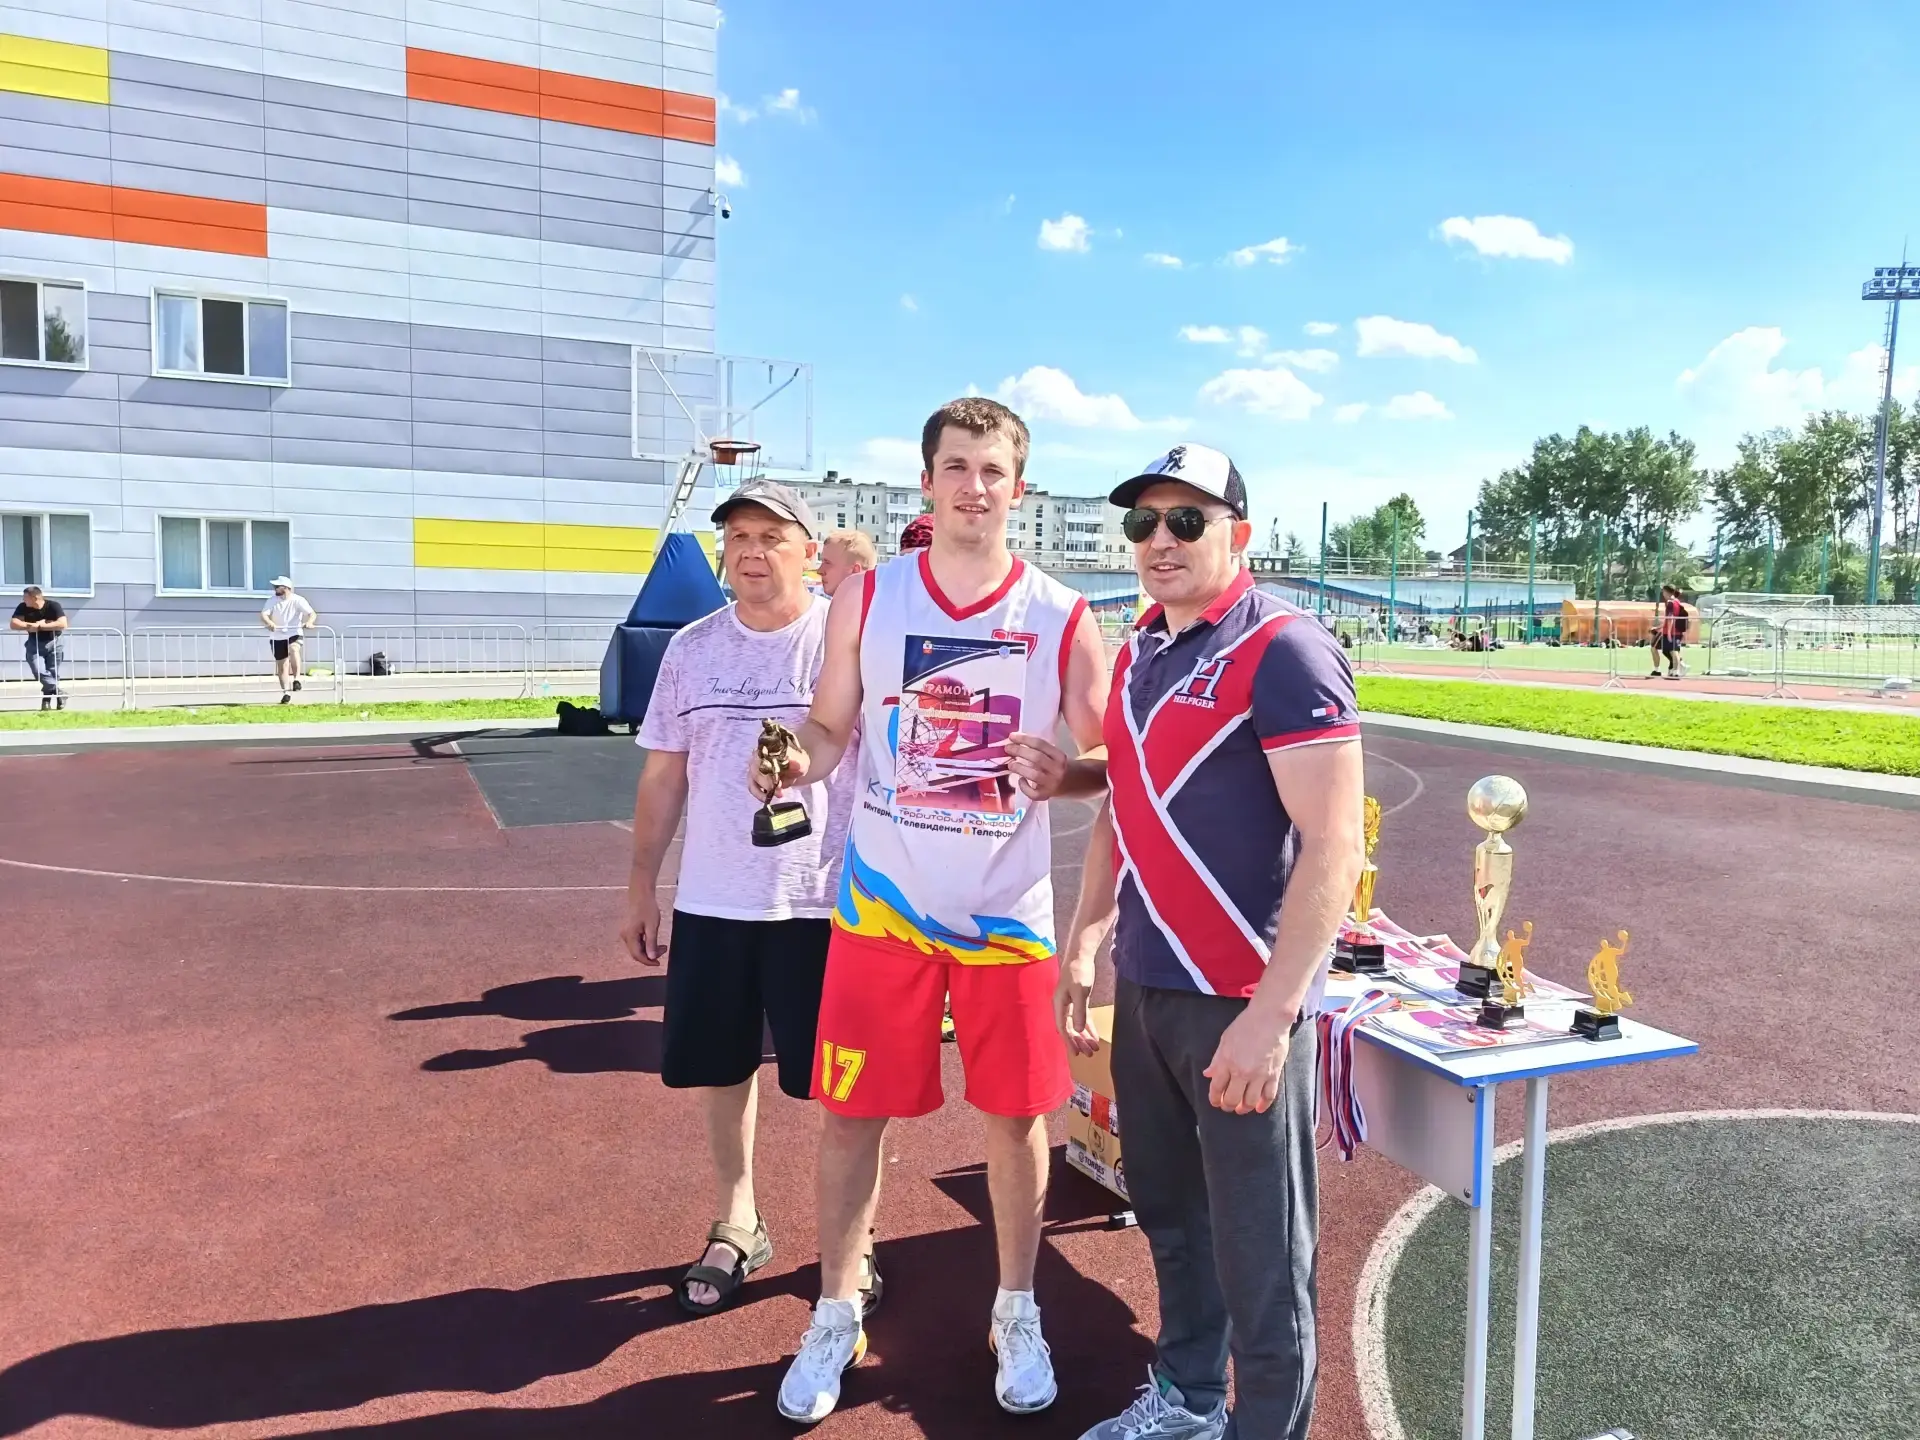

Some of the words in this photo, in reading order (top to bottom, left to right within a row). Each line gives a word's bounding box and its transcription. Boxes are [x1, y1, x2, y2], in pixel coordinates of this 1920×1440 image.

[991, 629, 1038, 662] 7
[1175, 656, 1233, 700] H
[731, 677, 782, 701] Legend
[923, 683, 976, 697] ГРАМОТА
[1173, 695, 1216, 709] HILFIGER
[900, 817, 962, 834] Телевидение
[821, 1039, 867, 1102] 17
[1085, 1156, 1105, 1175] TORRES
